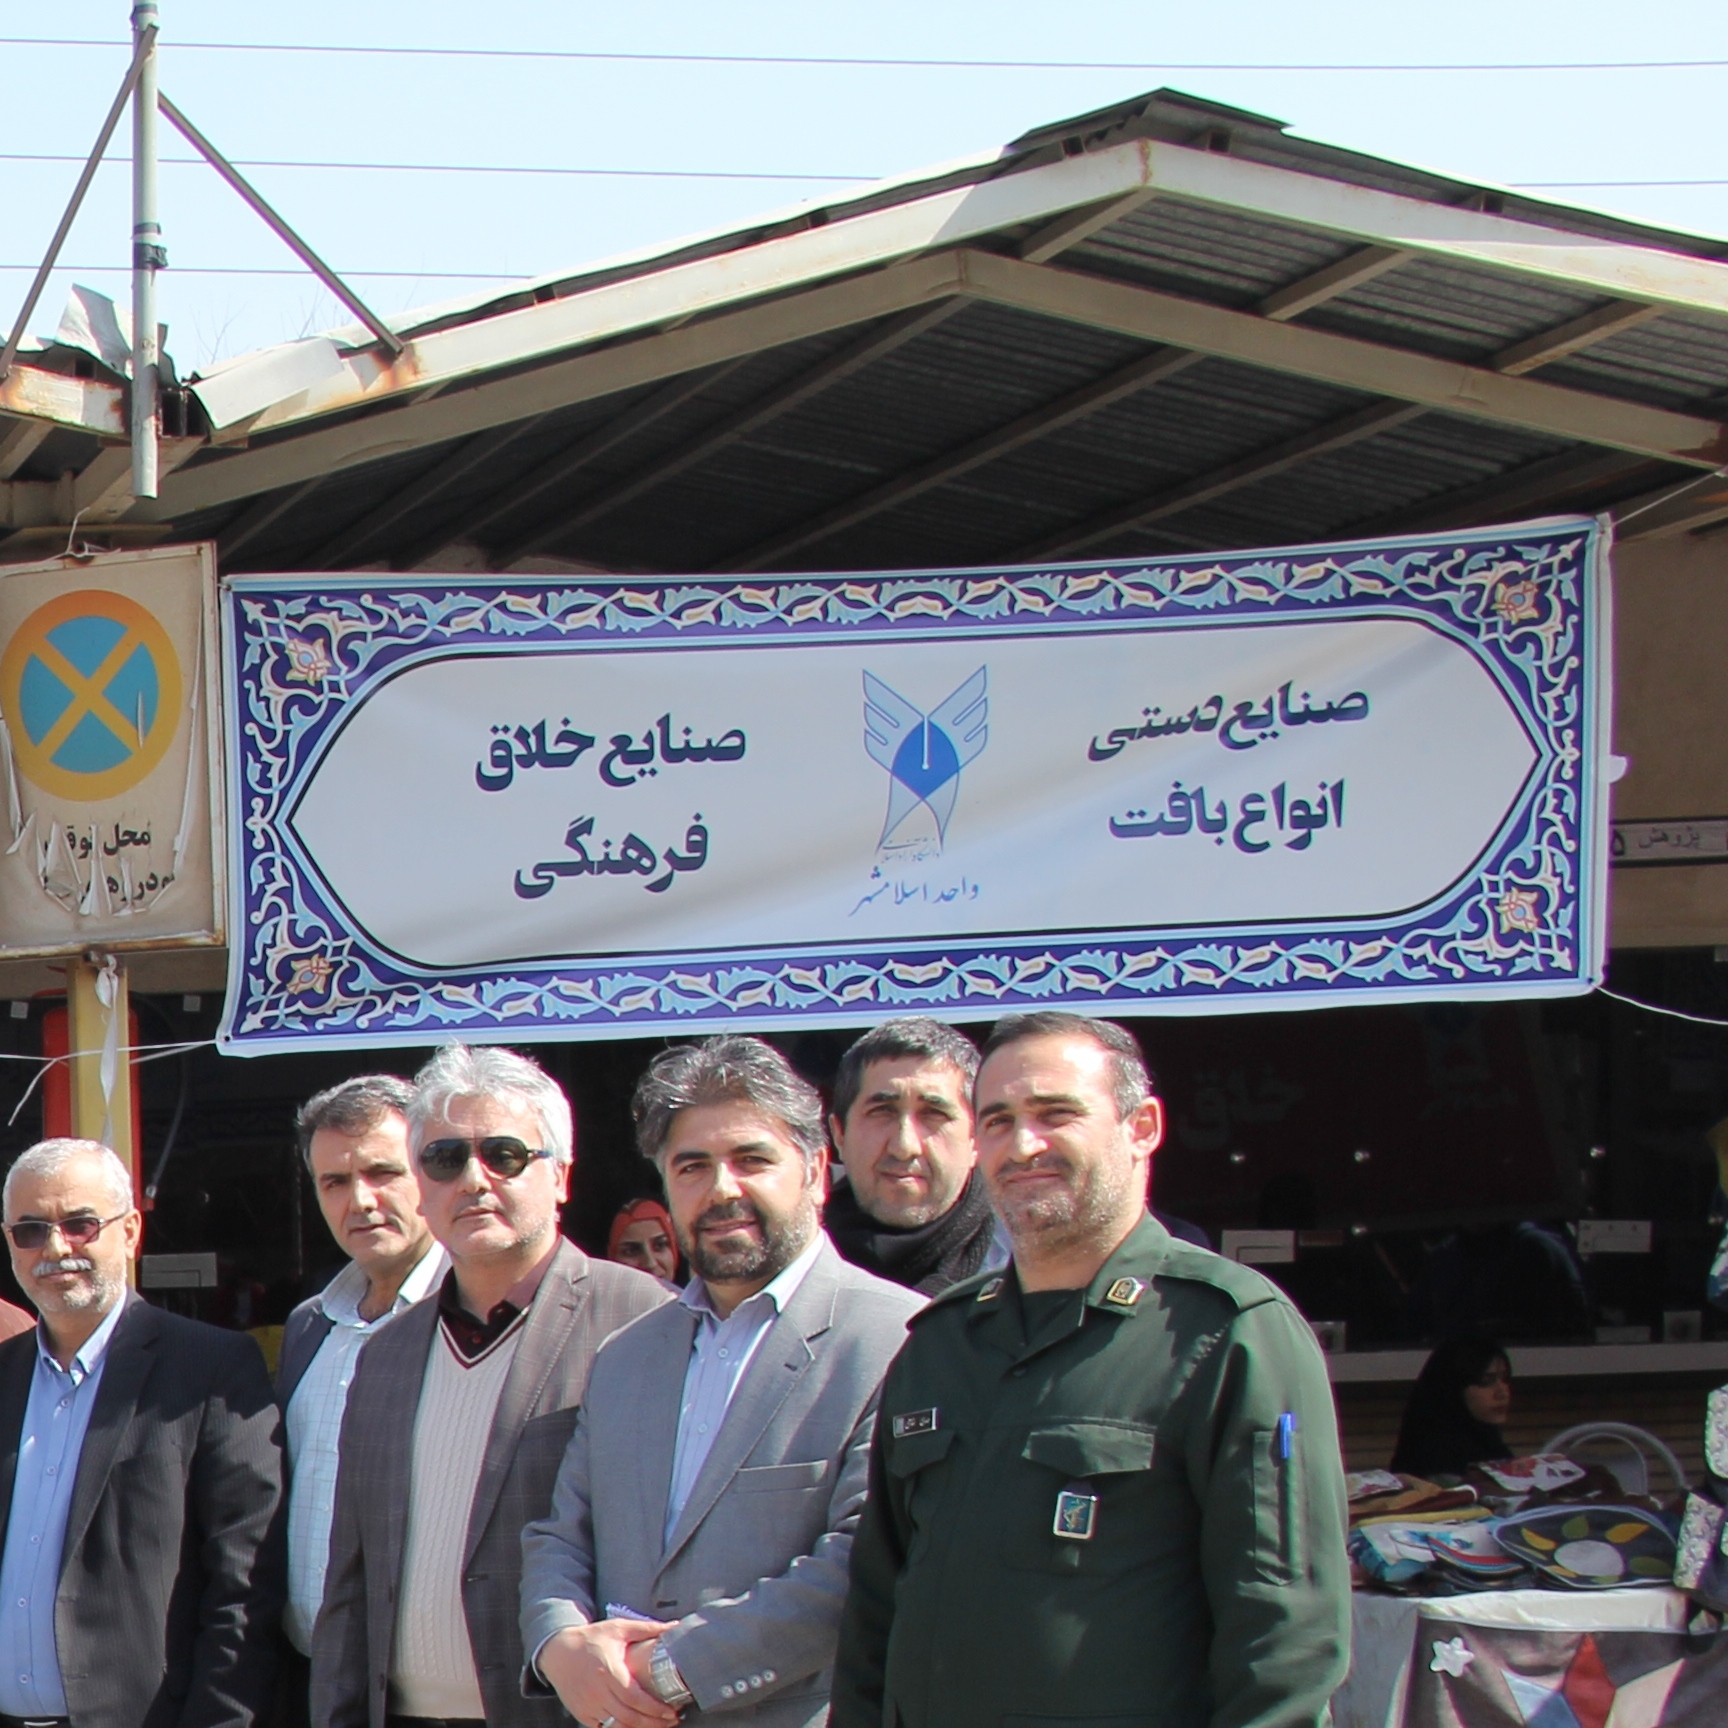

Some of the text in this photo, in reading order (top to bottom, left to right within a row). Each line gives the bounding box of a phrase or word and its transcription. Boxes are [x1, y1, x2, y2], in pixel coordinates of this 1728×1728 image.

[476, 713, 746, 792] صنایع خلاق
[1088, 681, 1369, 761] صنایع دستی
[104, 822, 151, 856] محل
[1110, 778, 1344, 854] انواع بافت
[515, 813, 709, 900] فرهنگی
[847, 865, 980, 917] واحد اسلامشهر
